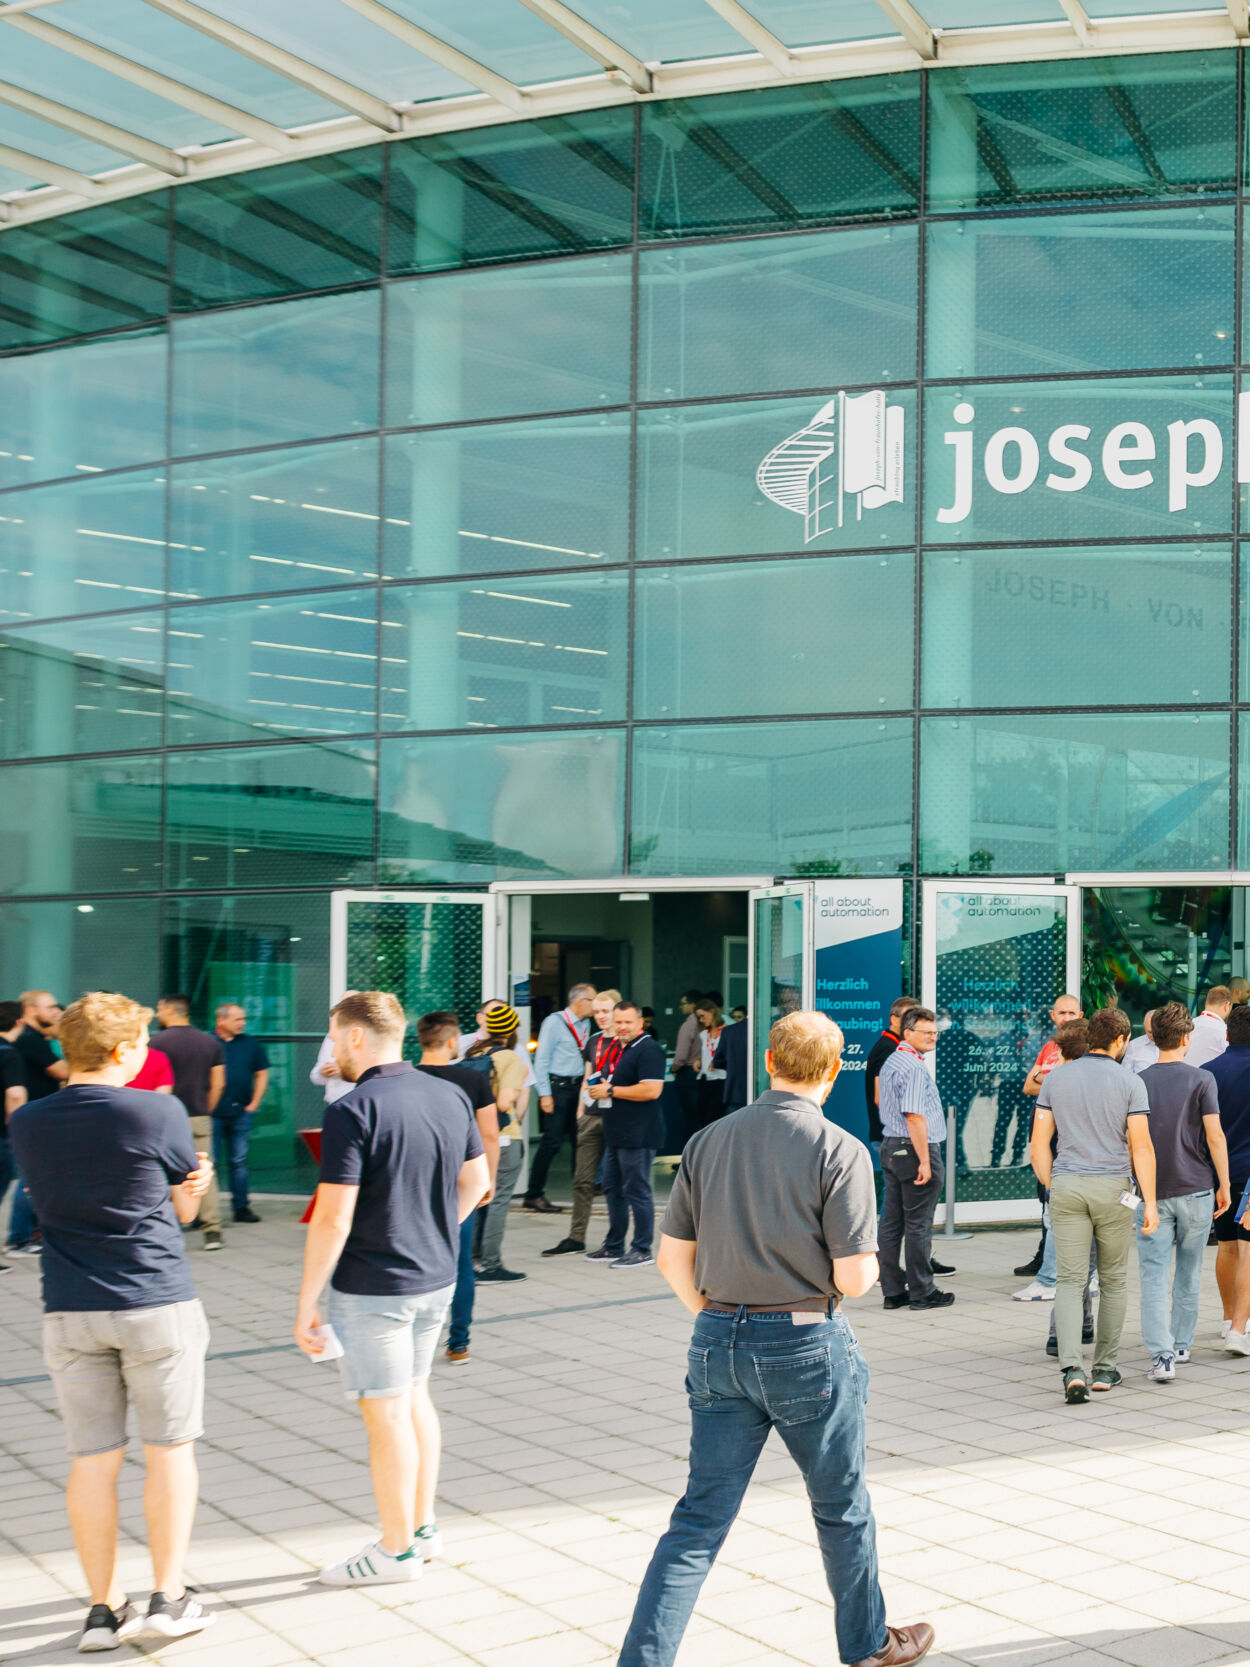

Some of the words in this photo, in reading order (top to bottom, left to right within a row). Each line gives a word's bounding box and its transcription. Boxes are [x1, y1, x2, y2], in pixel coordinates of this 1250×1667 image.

[986, 568, 1110, 614] JOSEPH
[1147, 597, 1204, 632] VON
[821, 897, 834, 907] all
[837, 896, 871, 907] about
[968, 896, 982, 906] all
[821, 906, 889, 917] automation
[968, 907, 1041, 917] automation
[817, 978, 869, 990] Herzlich
[963, 977, 1019, 991] Herzlich
[950, 998, 1031, 1010] willkommen
[847, 1044, 864, 1054] 27.
[968, 1045, 986, 1056] 26.
[996, 1045, 1013, 1056] 27.
[842, 1061, 867, 1071] 2024
[963, 1062, 987, 1072] Juni
[989, 1062, 1018, 1072] 2024
